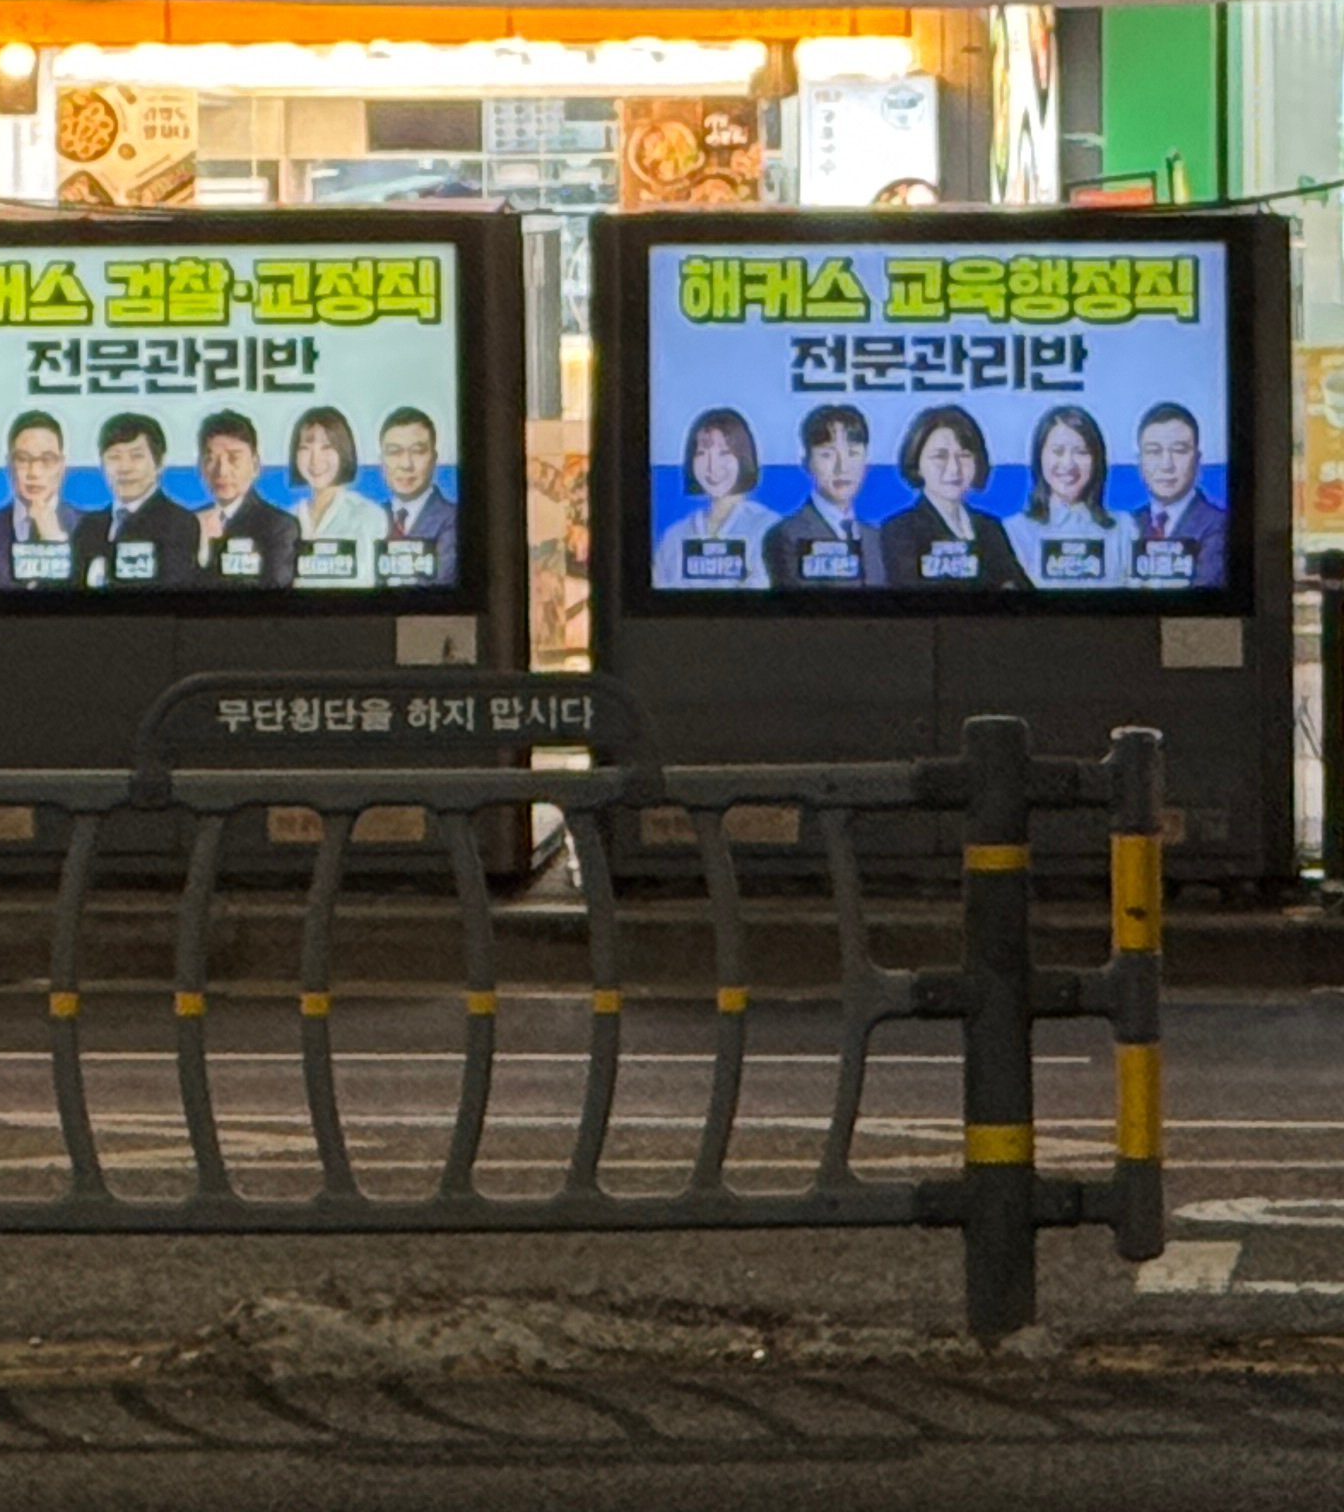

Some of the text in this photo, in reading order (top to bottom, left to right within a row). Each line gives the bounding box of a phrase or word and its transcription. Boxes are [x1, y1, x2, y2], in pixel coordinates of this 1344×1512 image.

[678, 254, 1200, 324] 해커스 교육행정직
[24, 335, 319, 395] 전문관리반
[789, 333, 1089, 393] 전문관리반
[216, 696, 394, 734] 무단횡단을
[407, 696, 476, 733] 하지
